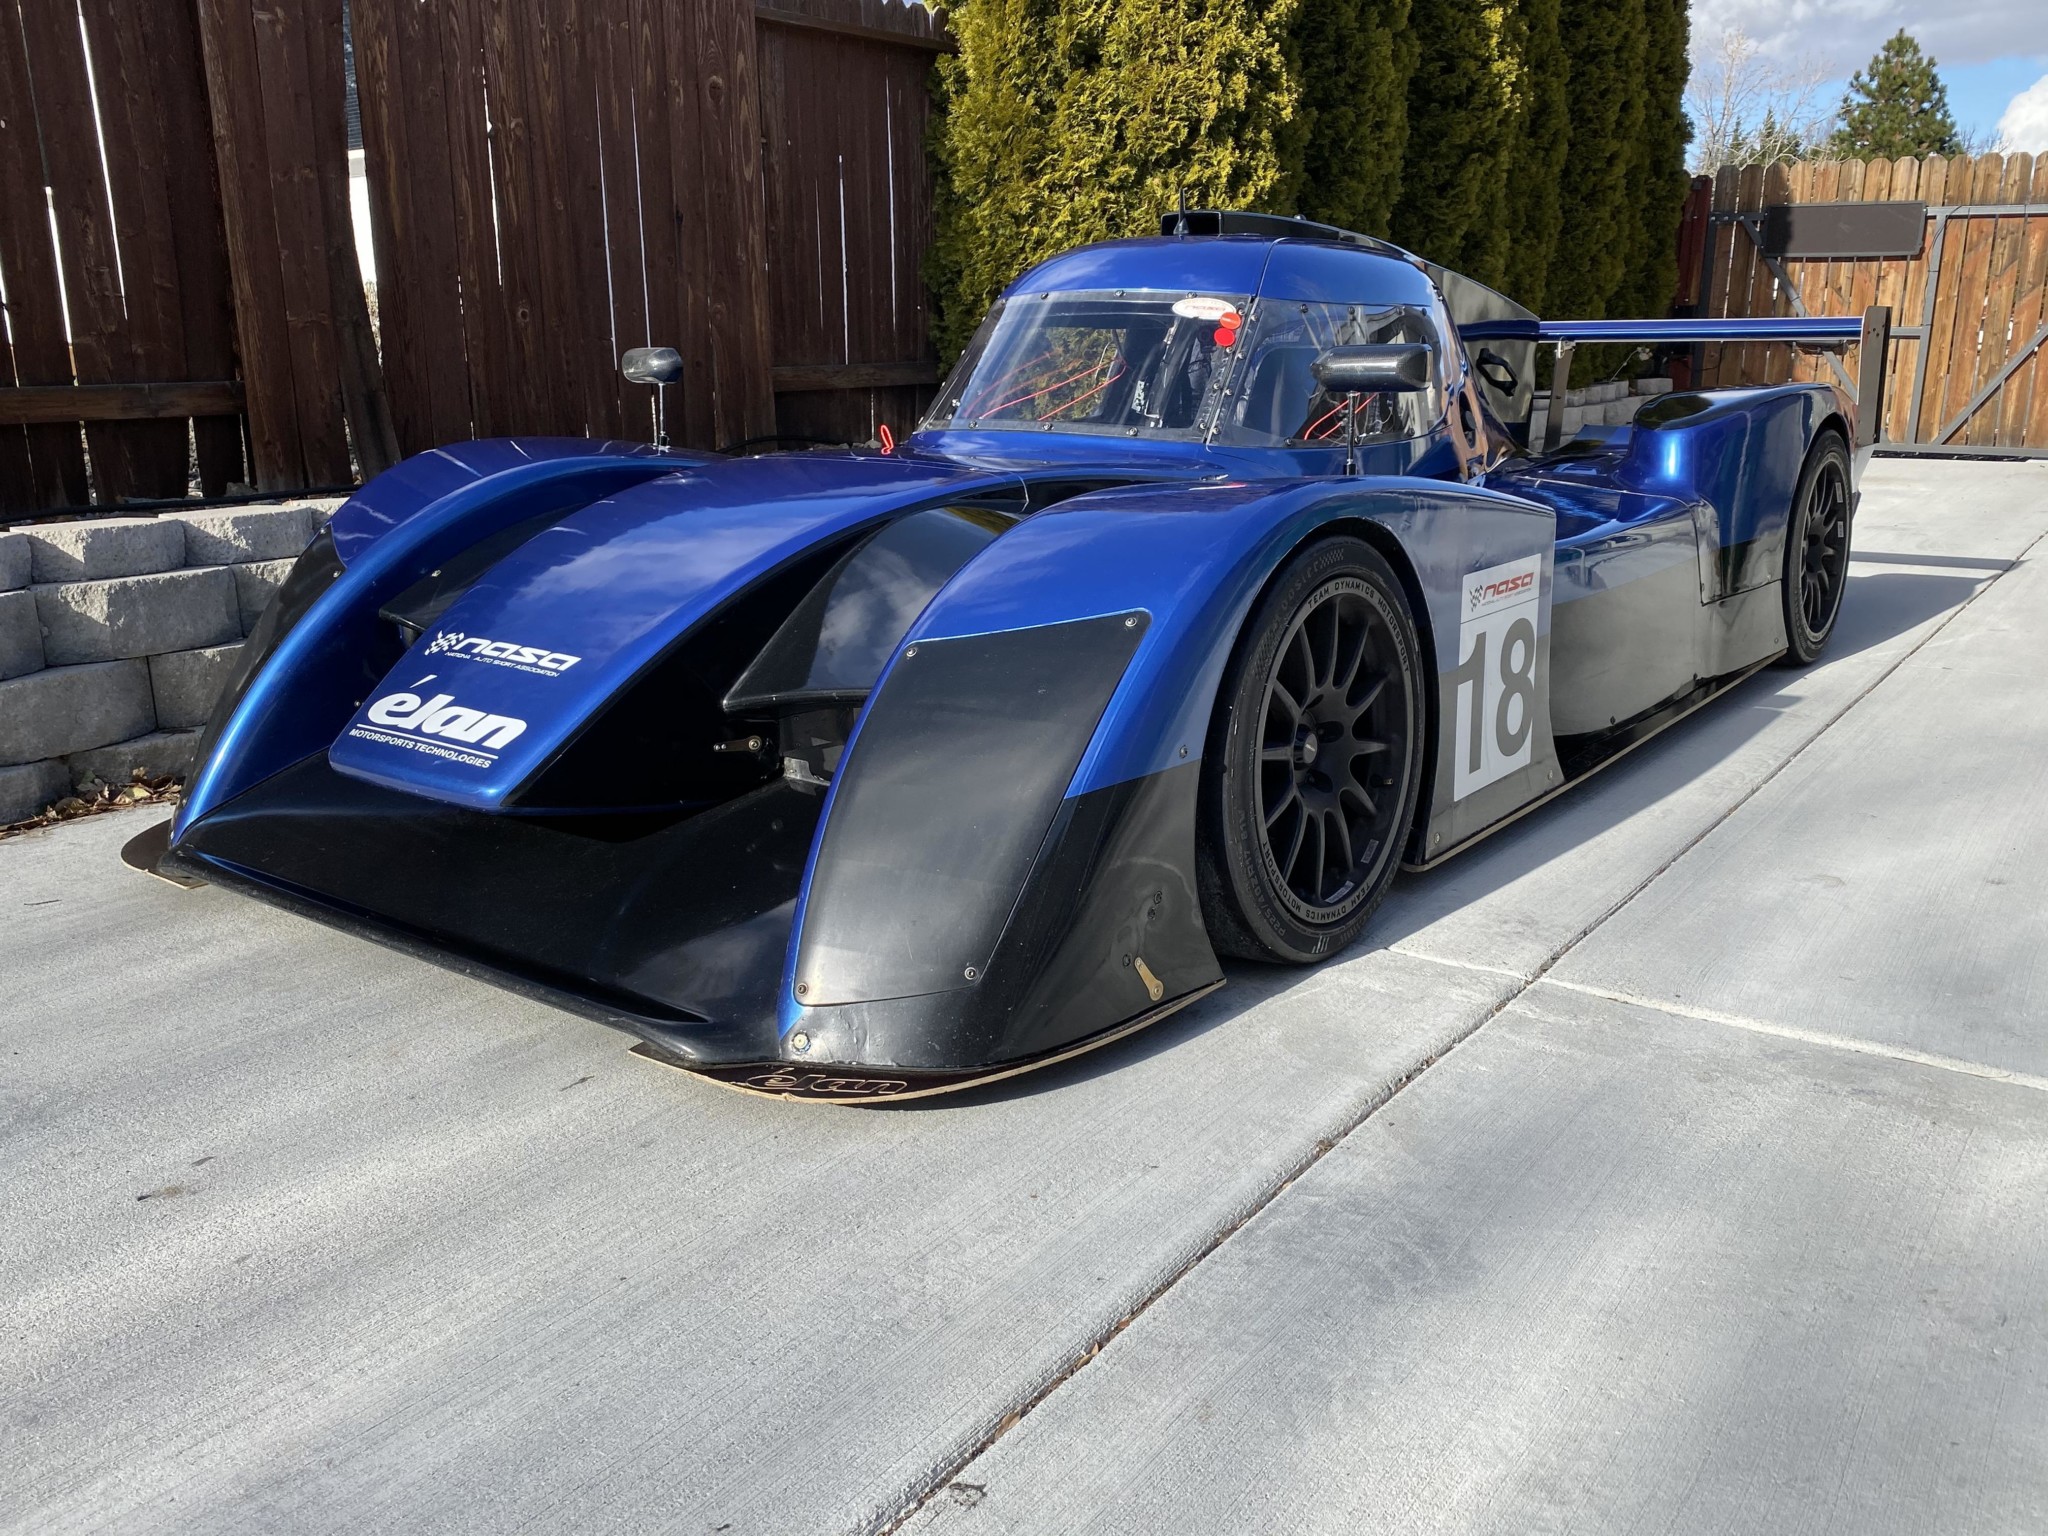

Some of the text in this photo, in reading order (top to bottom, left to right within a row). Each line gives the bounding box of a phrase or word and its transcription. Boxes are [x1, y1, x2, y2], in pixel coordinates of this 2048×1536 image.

[1482, 572, 1534, 601] nasa
[1307, 581, 1409, 673] TEAM DYNAMICS MOTORSPORT
[452, 637, 582, 672] nasa
[473, 656, 494, 664] AUTO
[492, 659, 516, 669] SPORT
[514, 664, 560, 678] ASSOCIATION
[367, 674, 528, 750] élan
[1457, 617, 1535, 775] 18
[349, 728, 492, 769] MOTORSPORTS TECHNOLOGIES
[1262, 840, 1302, 913] MOTORSPORT
[1351, 883, 1370, 907] TEAM
[1305, 905, 1347, 921] DYNAMICS
